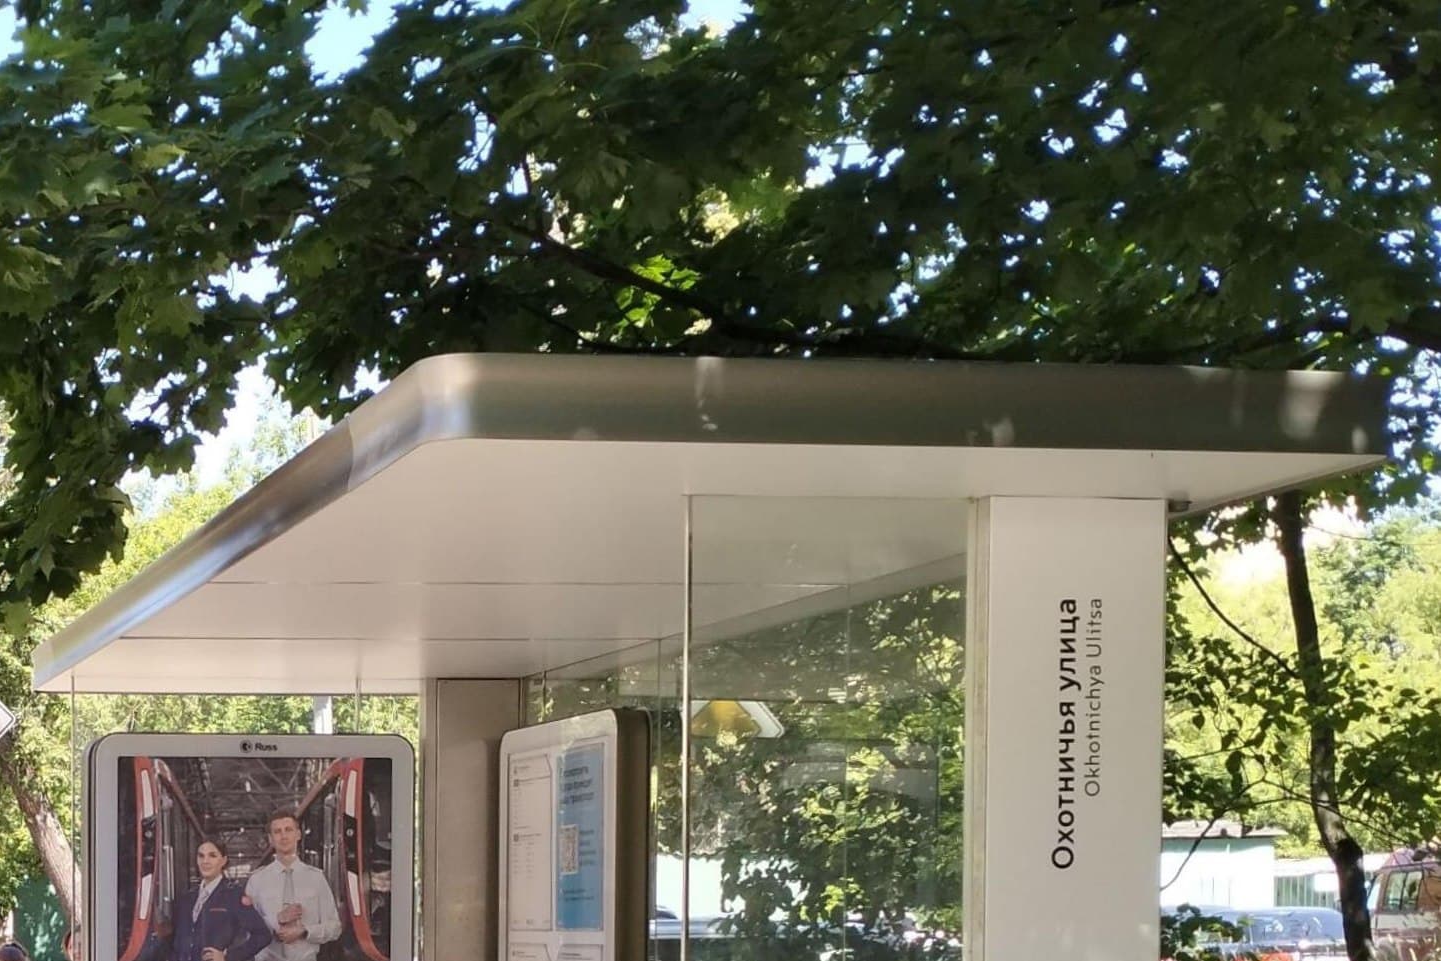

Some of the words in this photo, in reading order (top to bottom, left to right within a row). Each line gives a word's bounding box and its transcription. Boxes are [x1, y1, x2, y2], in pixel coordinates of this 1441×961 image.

[1059, 598, 1081, 691] улица
[1085, 598, 1102, 658] Ulitsa
[254, 742, 278, 751] Russ
[1084, 664, 1104, 797] Okhotnichya
[1051, 701, 1076, 869] Охотничья
